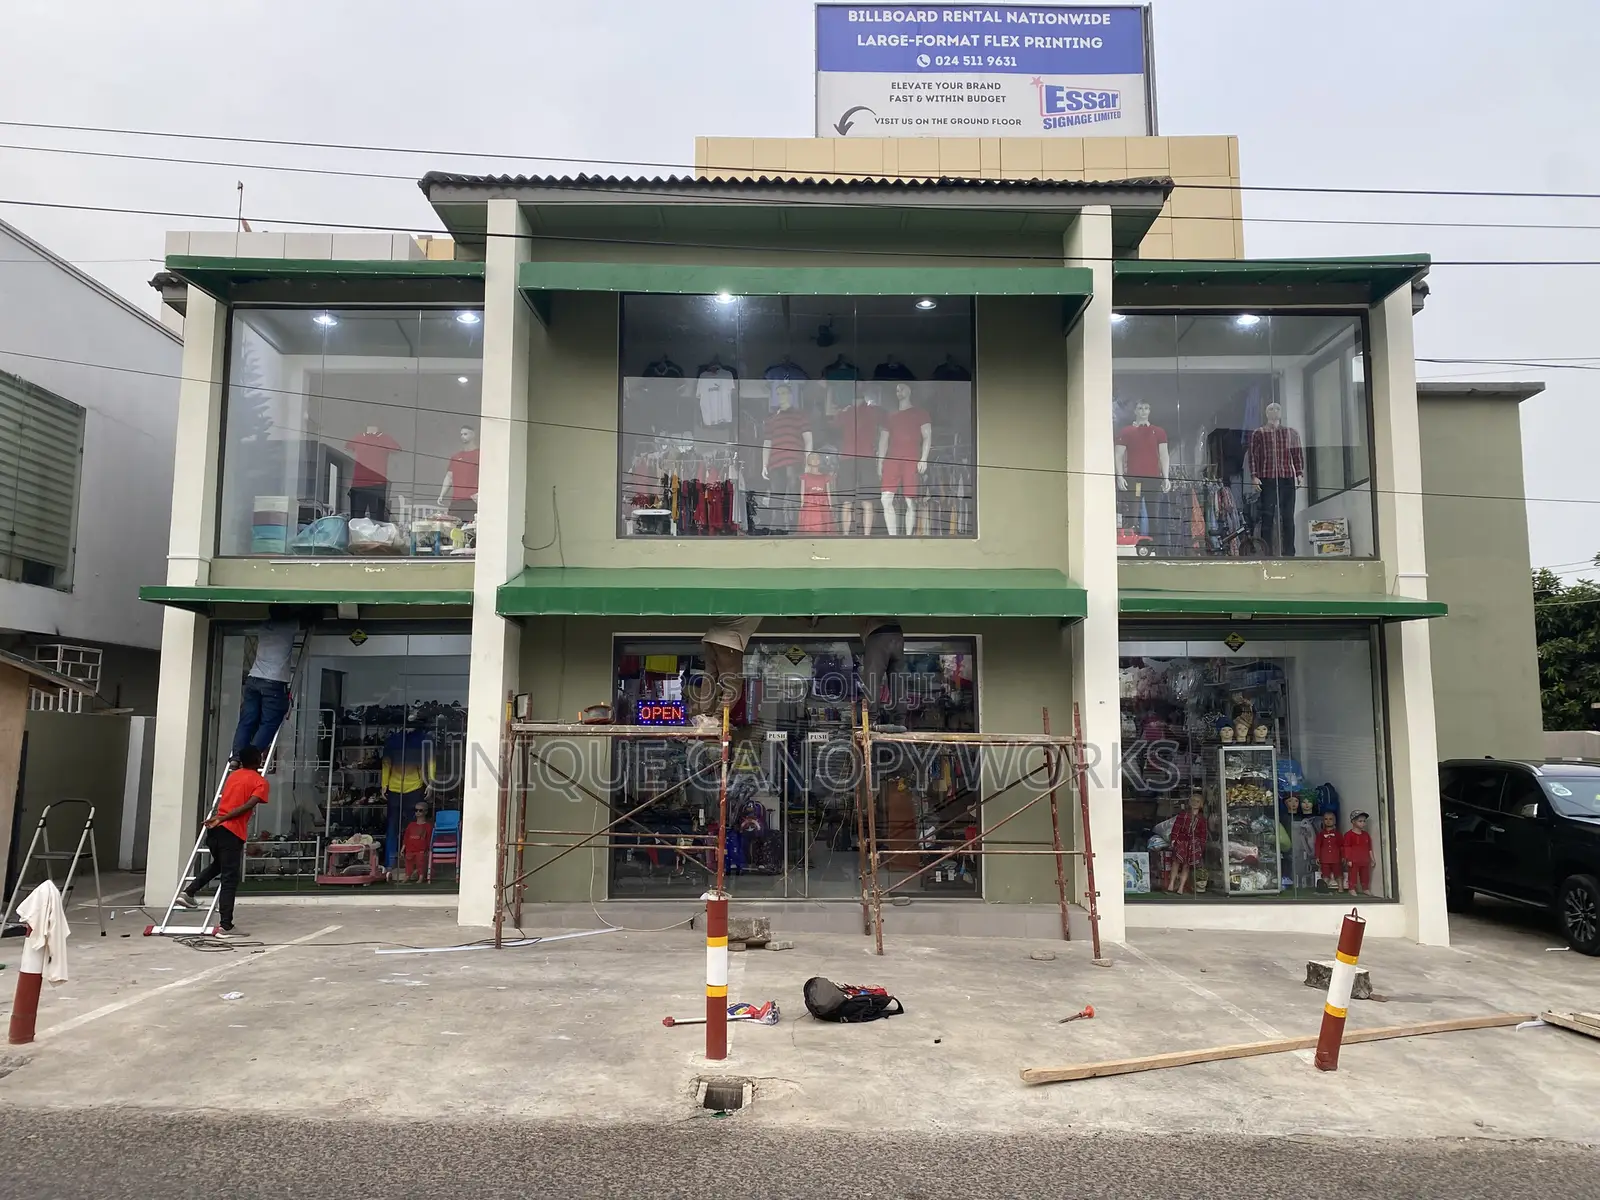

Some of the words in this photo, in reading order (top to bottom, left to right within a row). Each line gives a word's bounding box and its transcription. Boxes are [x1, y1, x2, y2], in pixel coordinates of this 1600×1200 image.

[848, 10, 938, 22] BILLBOARD
[943, 10, 1002, 23] RENTAL
[1006, 11, 1111, 25] NATIONWIDE
[857, 34, 979, 46] LARGE-FORMAT
[984, 35, 1020, 47] FLEX
[1024, 36, 1103, 49] PRINTING
[935, 55, 959, 66] 024
[963, 55, 983, 66] 511
[986, 56, 1017, 66] 9631
[891, 82, 933, 90] ELEVATE
[935, 82, 963, 90] YOUR
[966, 82, 1001, 90] BRAND
[889, 95, 914, 103] FAST
[916, 95, 923, 103] &
[926, 95, 964, 103] WITHIN
[967, 95, 1006, 103] BUDGET
[1045, 84, 1119, 114] Essar
[992, 118, 1022, 126] FLOOR
[1043, 113, 1093, 130] SIGNAGE
[1094, 111, 1121, 123] LIMITED
[641, 706, 682, 720] OPEN
